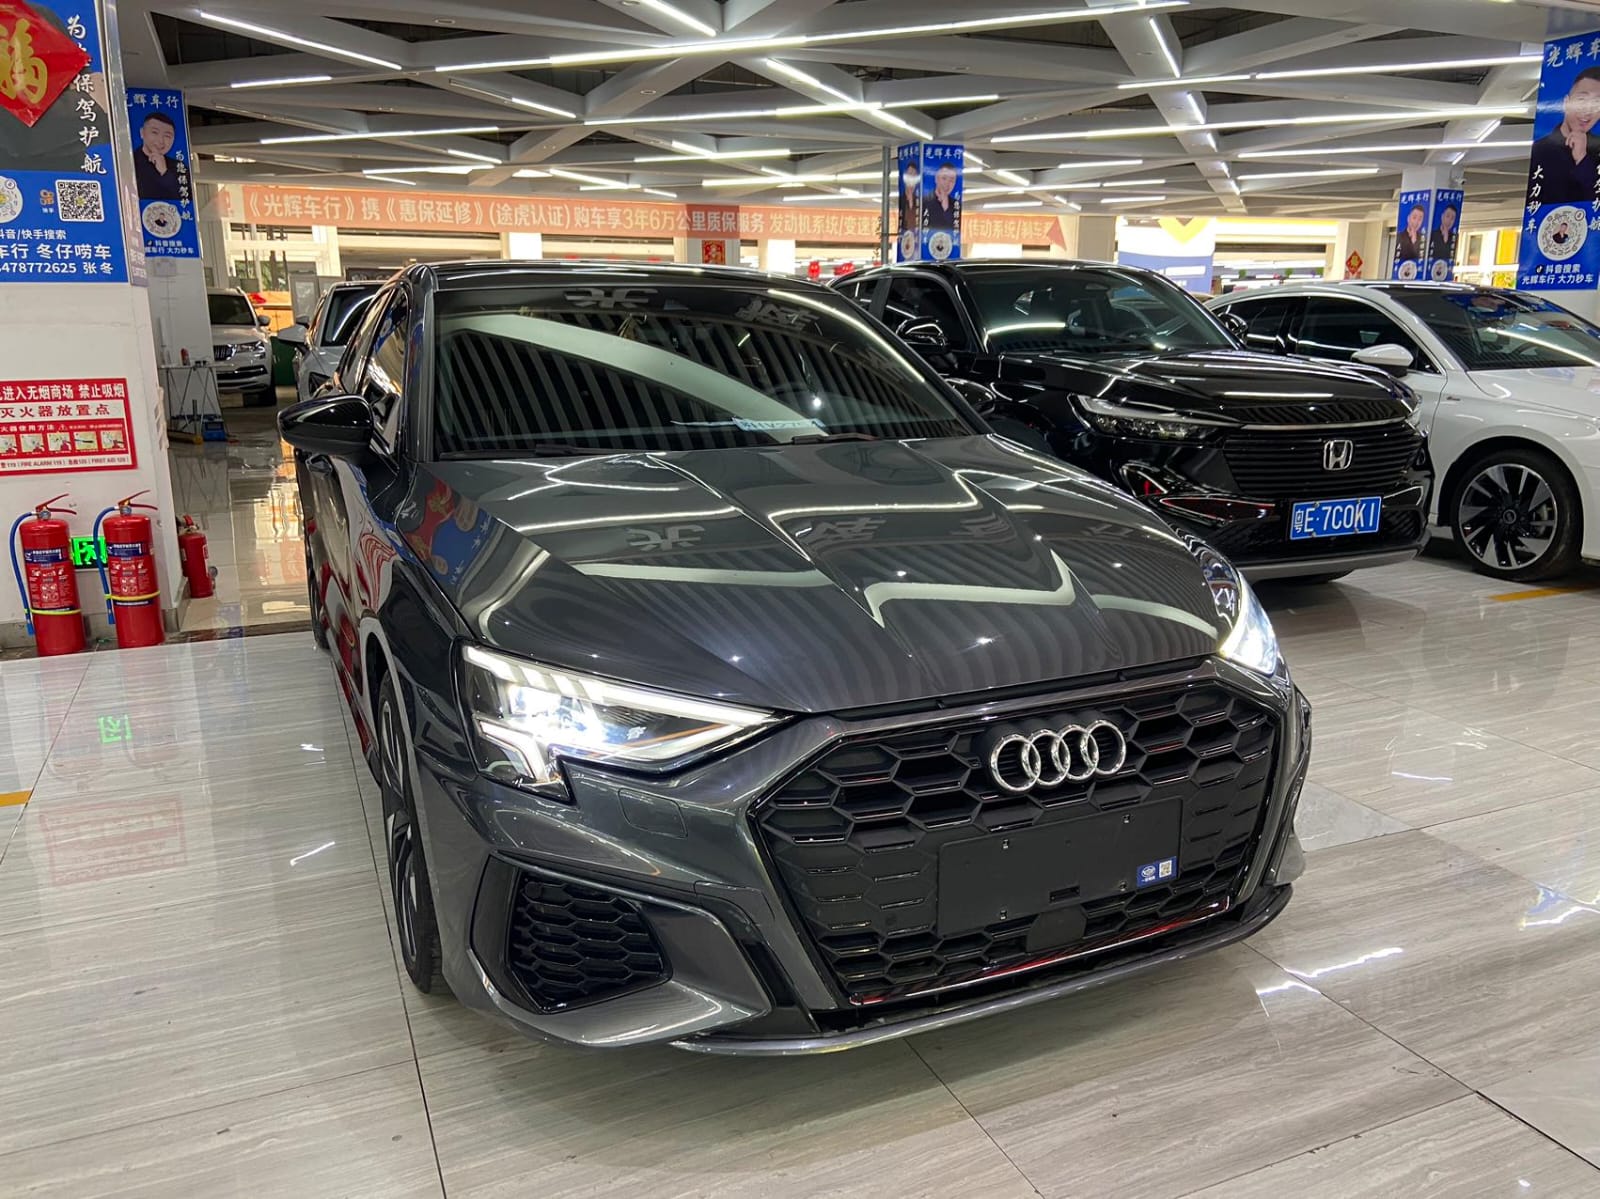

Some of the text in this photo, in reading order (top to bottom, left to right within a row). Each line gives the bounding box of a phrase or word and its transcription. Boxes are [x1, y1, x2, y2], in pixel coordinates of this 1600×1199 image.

[67, 14, 107, 174] 为保驾护航
[36, 243, 112, 259] 冬仔唠车
[0, 262, 77, 273] 478772625
[1522, 275, 1555, 285] 光辉车行
[0, 383, 125, 400] 进入无烟商场 禁止吸烟
[0, 403, 110, 418] 灭火器放置点
